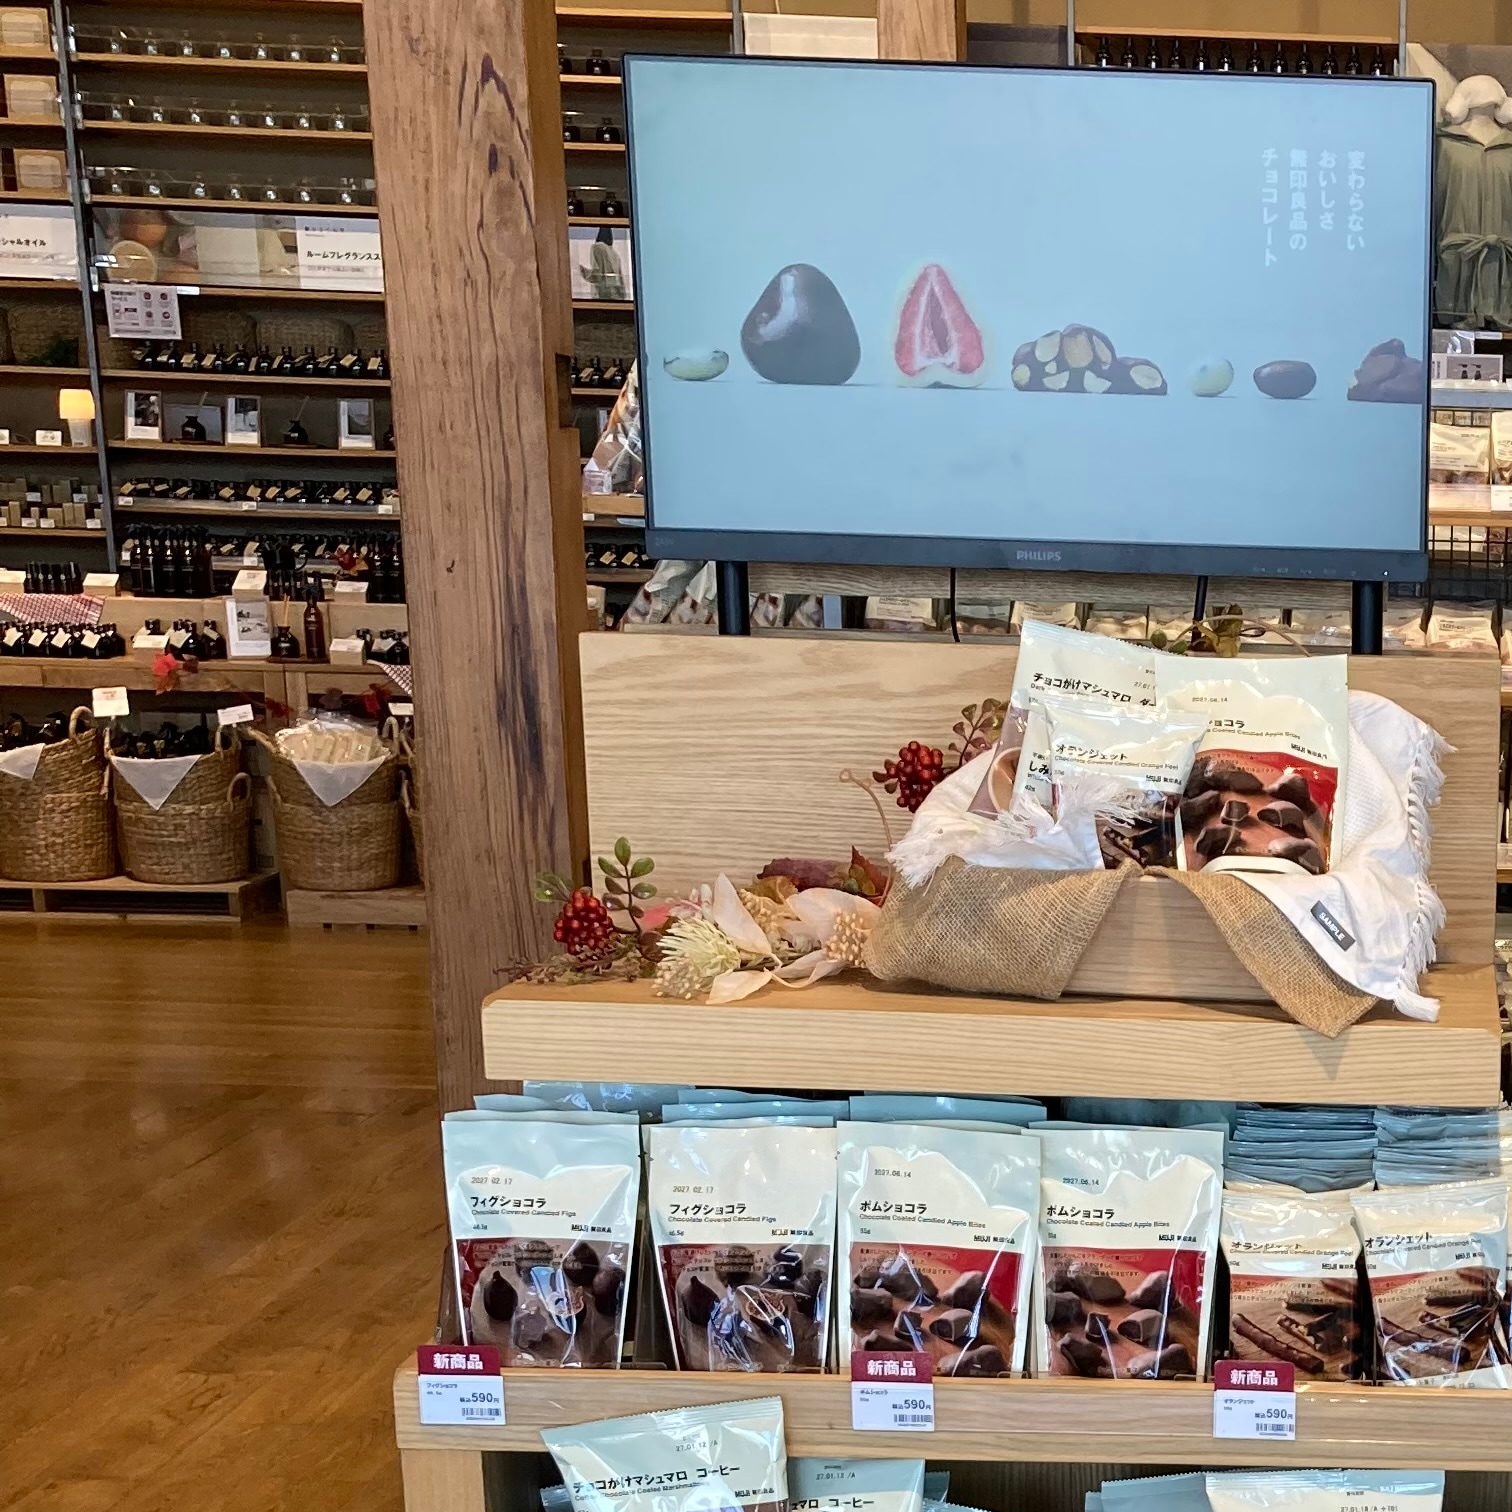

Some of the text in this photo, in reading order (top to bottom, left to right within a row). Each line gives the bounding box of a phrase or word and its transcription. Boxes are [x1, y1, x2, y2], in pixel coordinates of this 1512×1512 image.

[1319, 150, 1336, 230] おいしさ
[1262, 149, 1278, 267] チョコレート
[1290, 150, 1307, 250] 無印良品の
[1348, 151, 1365, 250] 変わらない
[1016, 550, 1061, 562] PHILIPS
[1033, 672, 1132, 703] チョコがけマシュマロ
[1318, 912, 1345, 942] SAMPLE
[470, 1195, 546, 1209] フィグショコラ
[669, 1203, 747, 1215] フィグショコラ
[860, 1200, 927, 1214] ポムショコラ
[1046, 1205, 1115, 1219] ポムショコラ
[433, 1353, 483, 1370] 新商品
[867, 1359, 916, 1377] 新商品
[1230, 1369, 1278, 1386] 新商品
[696, 1465, 740, 1478] コーヒー
[829, 1497, 875, 1508] コーヒー
